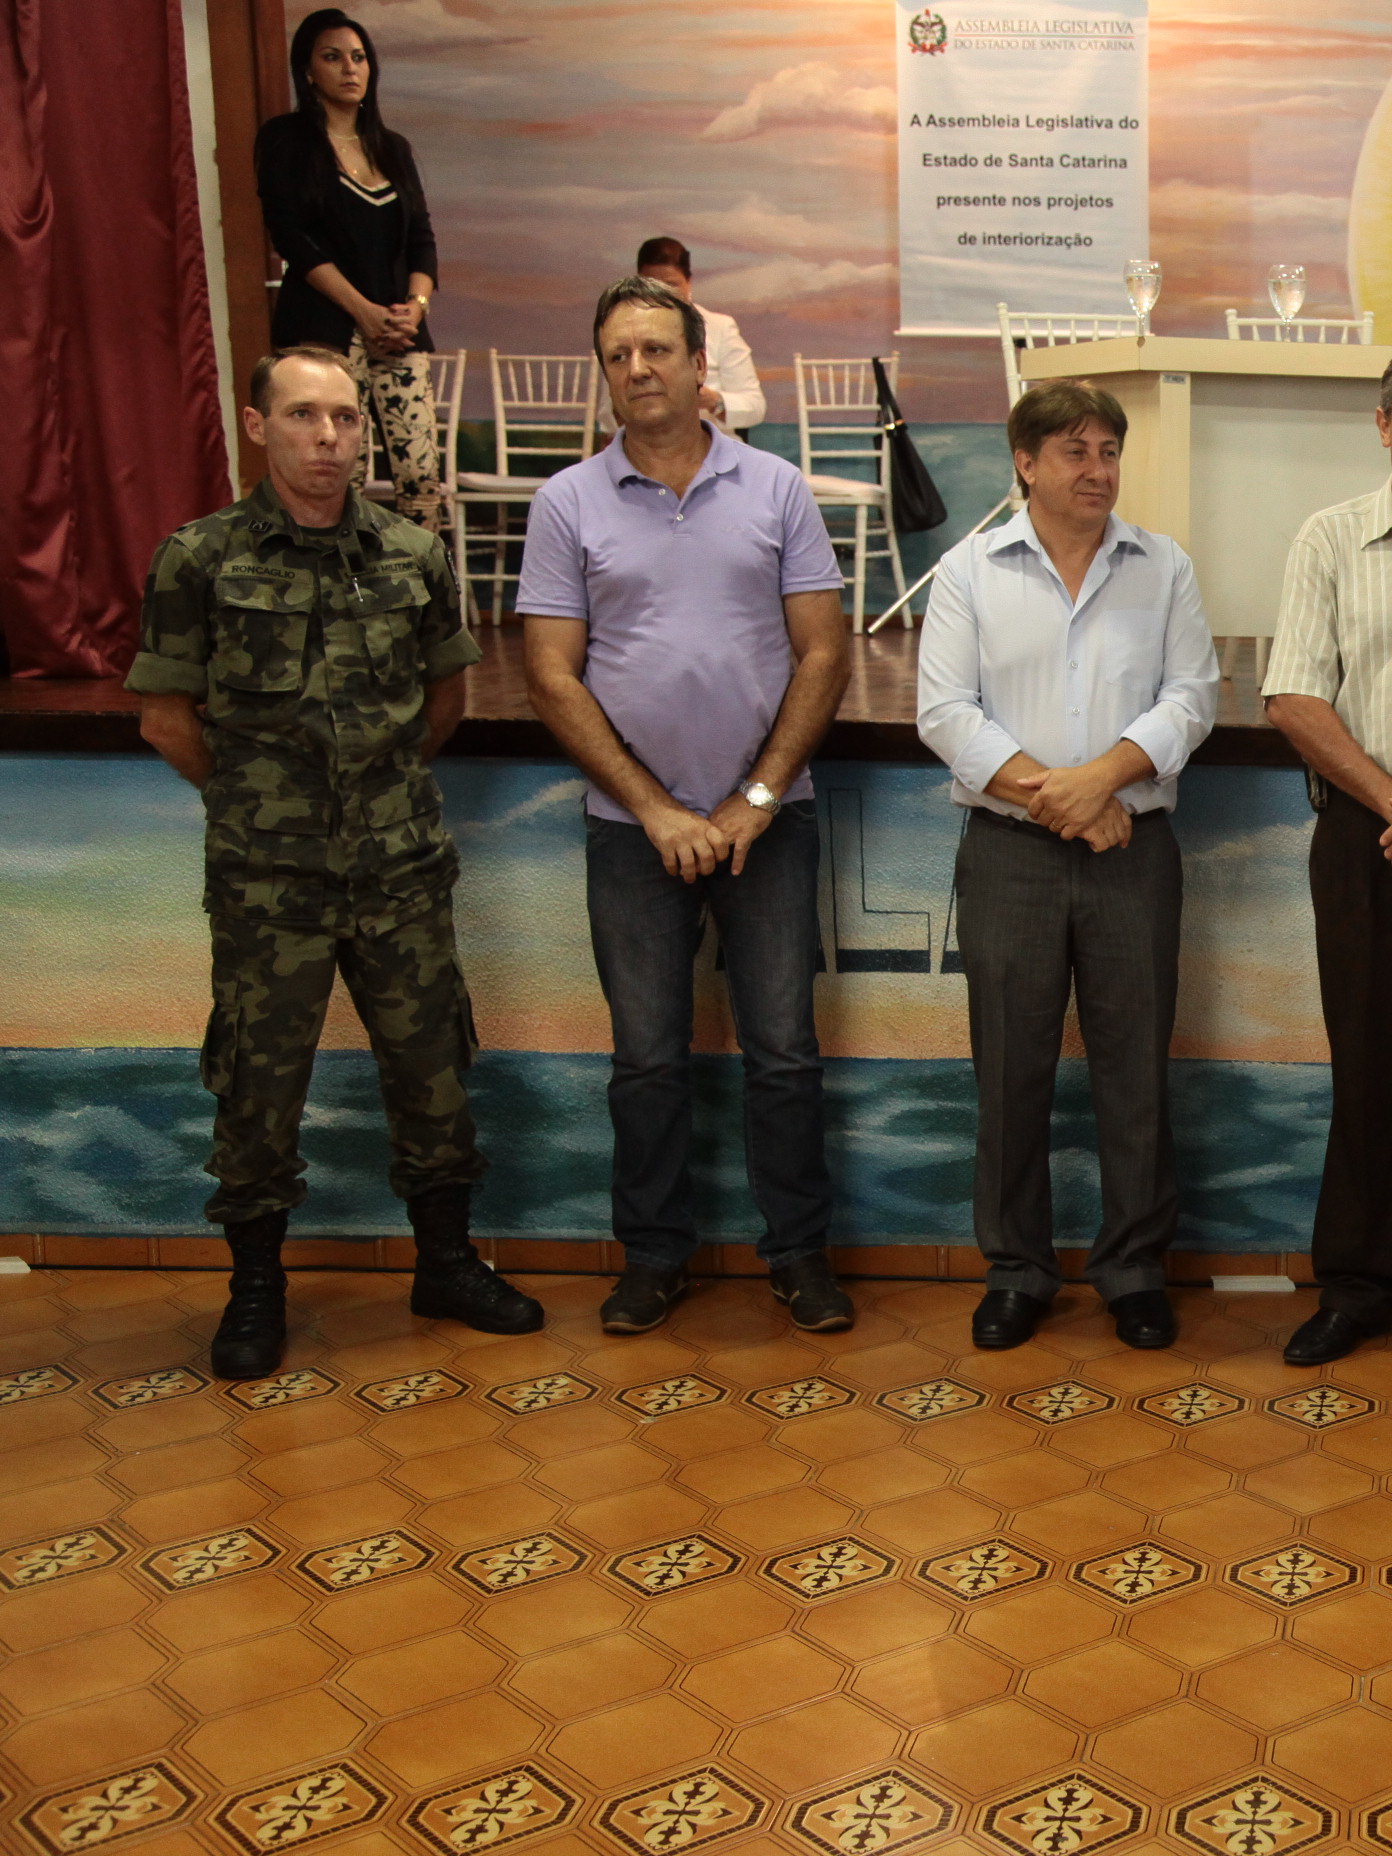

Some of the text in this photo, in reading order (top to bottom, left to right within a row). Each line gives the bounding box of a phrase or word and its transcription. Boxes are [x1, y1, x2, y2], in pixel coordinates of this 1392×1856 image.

[954, 19, 1134, 34] ASSEMBLEIA LEGISLATIVA
[954, 39, 1135, 51] DO ESTADO DE SANTA CATARINA
[910, 114, 1139, 131] A Assembleia Legislativa do
[922, 153, 1128, 169] Estado de Santa Catarina
[936, 194, 1114, 211] presente nos projetos
[958, 232, 1093, 249] de interiorização
[231, 565, 295, 579] RONCAGLIO
[381, 562, 413, 574] MILITAR
